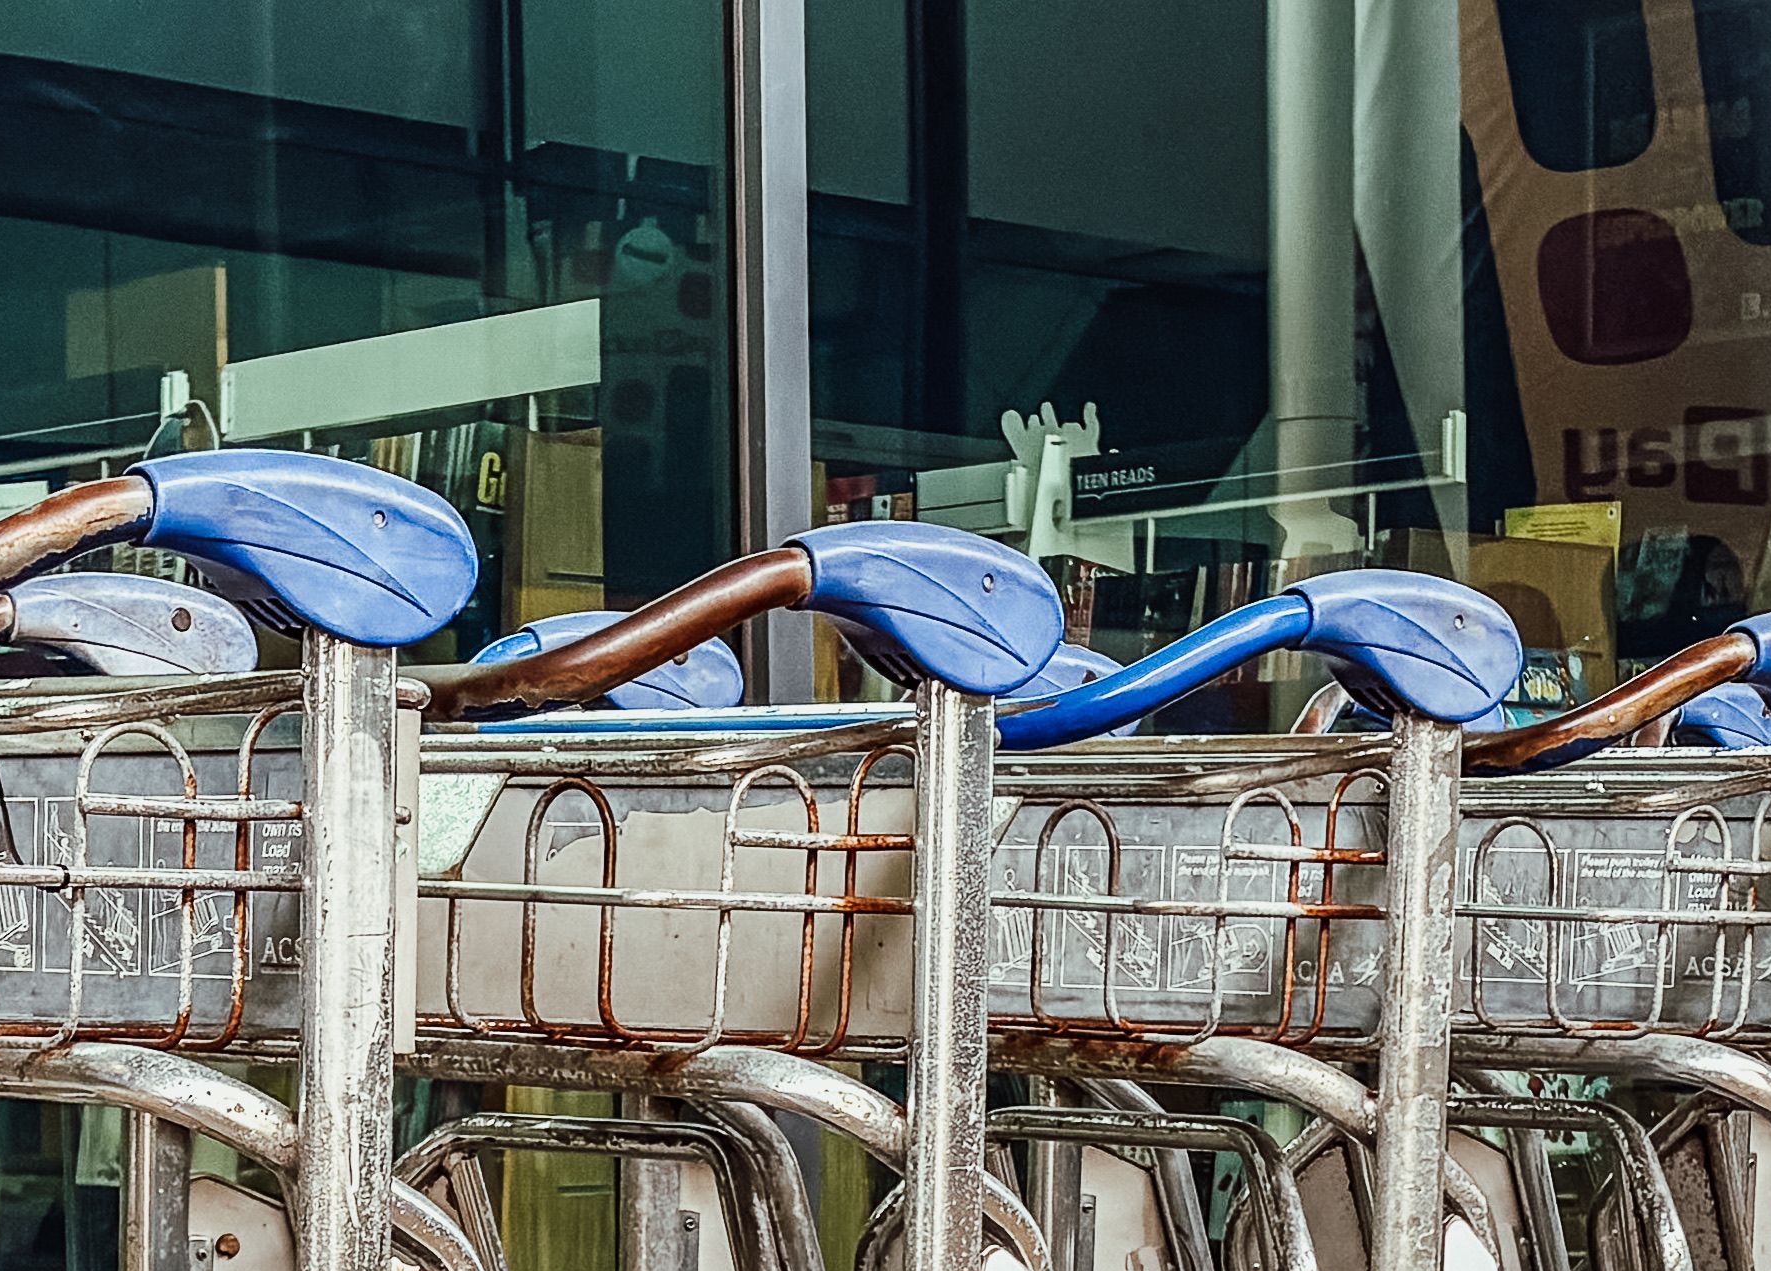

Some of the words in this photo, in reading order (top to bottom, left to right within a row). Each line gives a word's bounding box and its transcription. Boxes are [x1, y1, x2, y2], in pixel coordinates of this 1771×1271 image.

[1076, 472, 1109, 491] TEEN
[1111, 466, 1156, 486] READS
[262, 840, 292, 858] Load
[1687, 886, 1718, 899] Load
